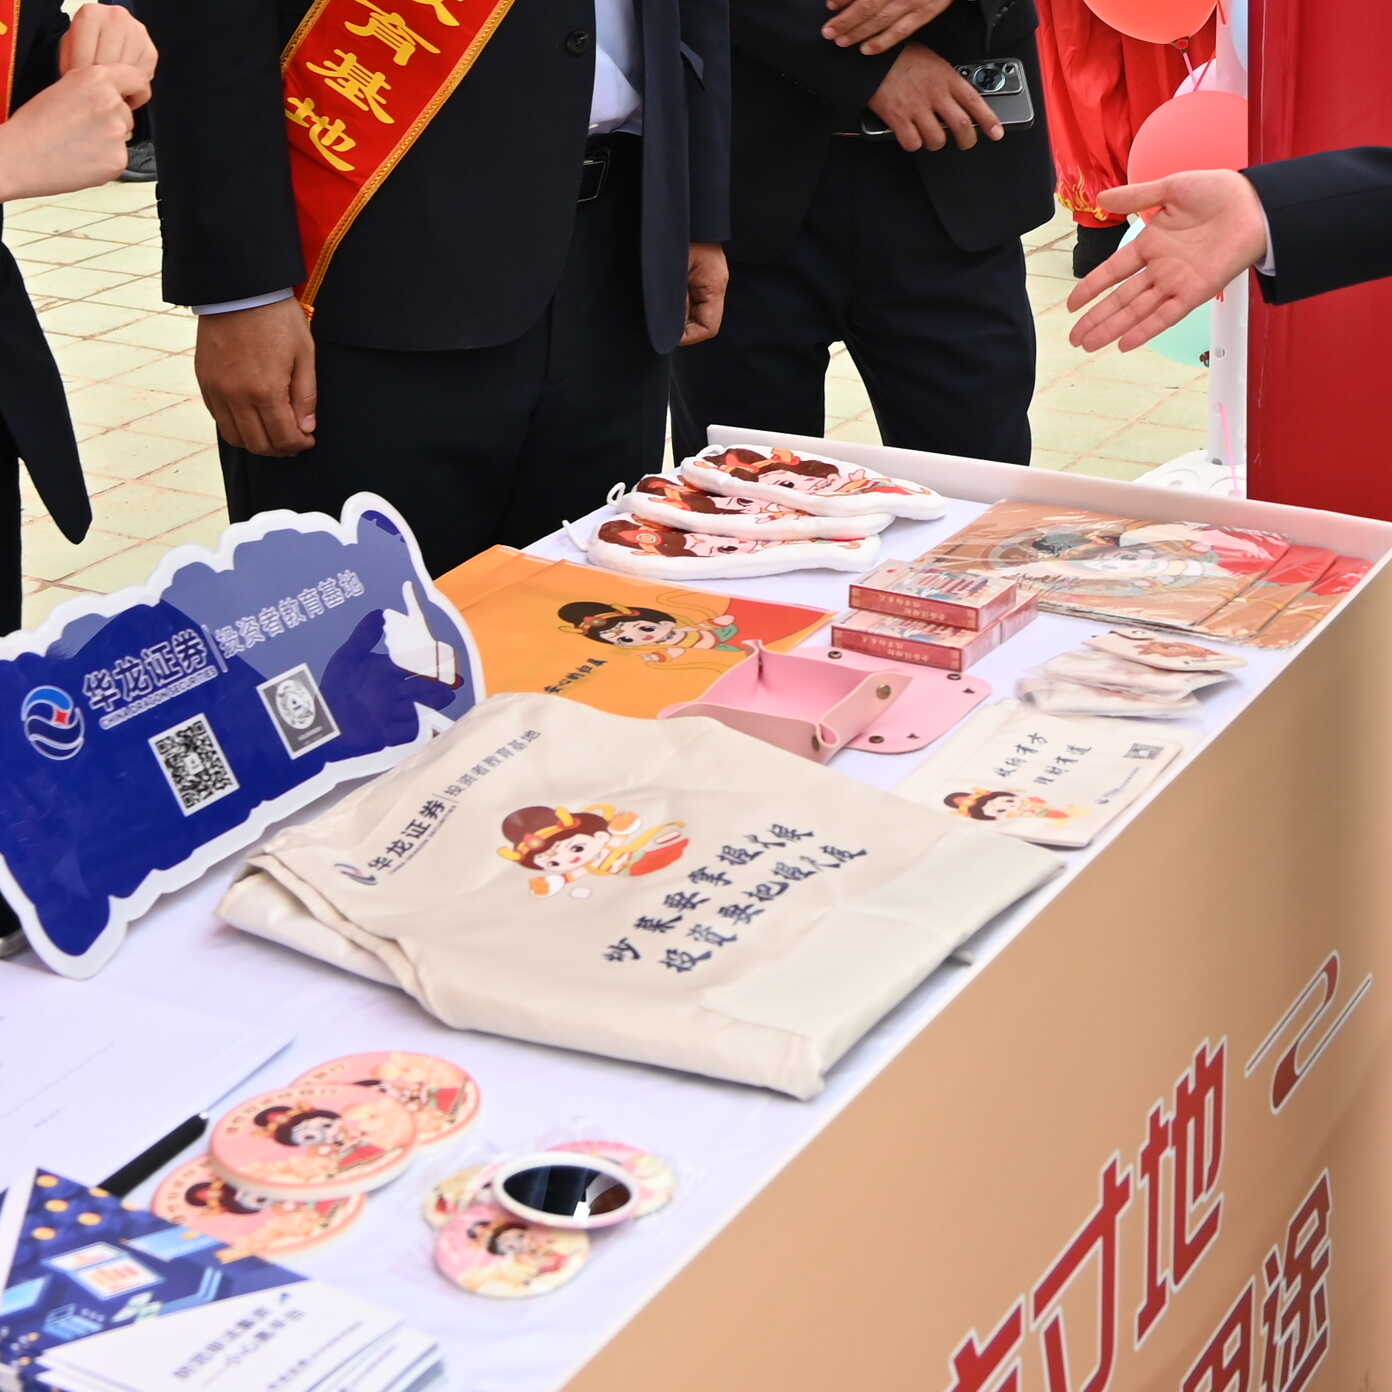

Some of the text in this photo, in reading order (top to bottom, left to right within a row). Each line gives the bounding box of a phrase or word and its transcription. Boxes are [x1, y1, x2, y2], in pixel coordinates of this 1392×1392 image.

[214, 570, 365, 659] 投资者教育基地
[82, 628, 209, 711] 华龙证券
[444, 729, 542, 797] 投资者教育基地
[368, 799, 447, 870] 华龙证券
